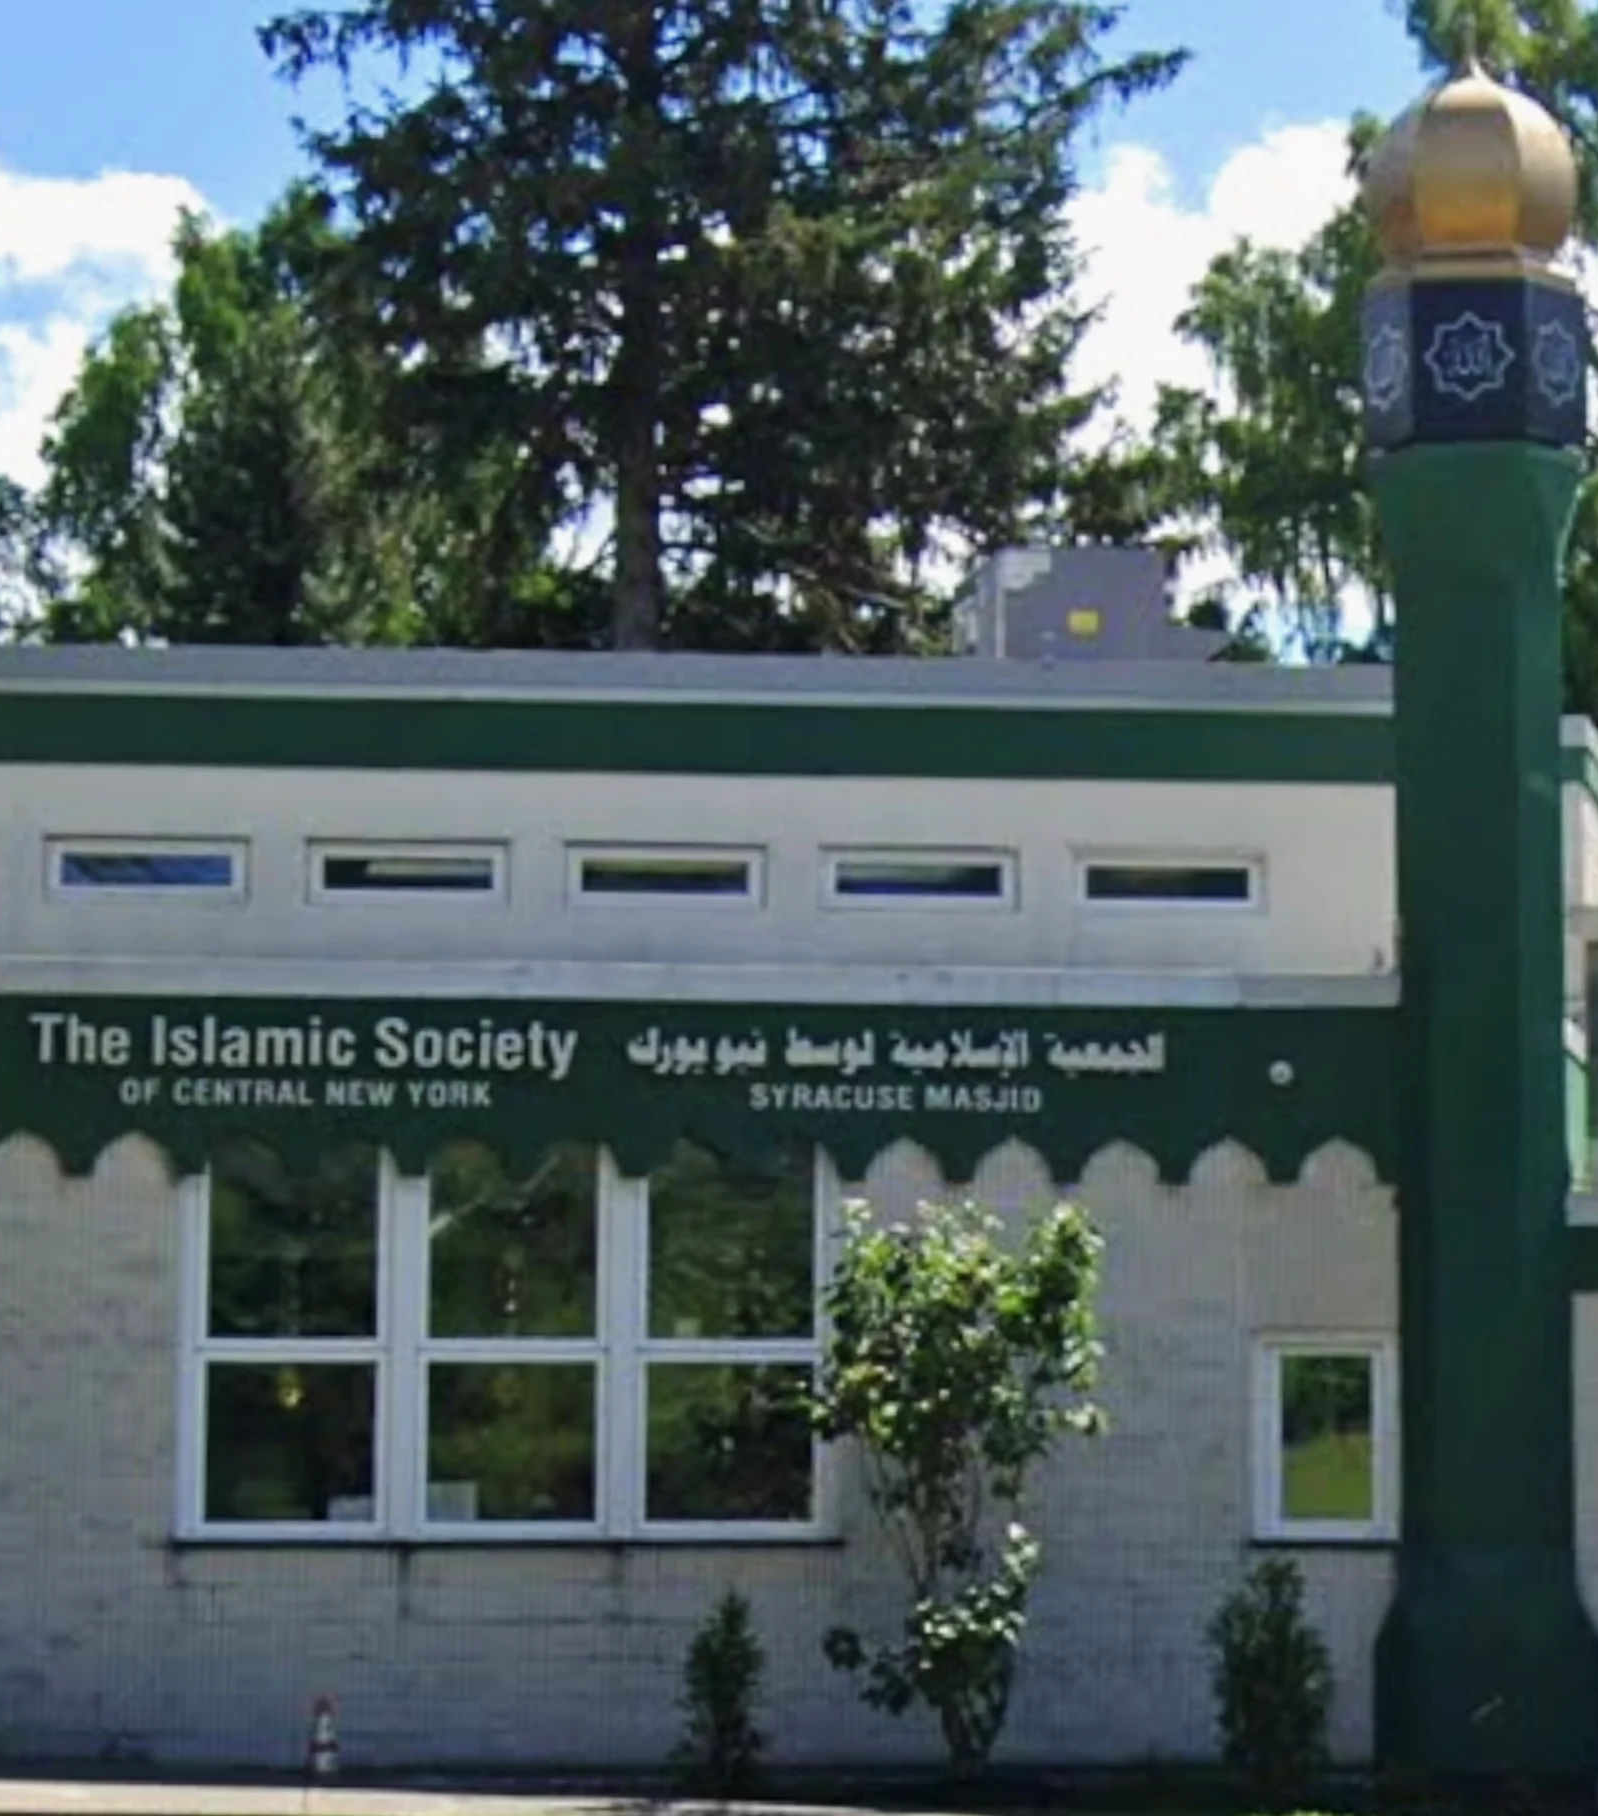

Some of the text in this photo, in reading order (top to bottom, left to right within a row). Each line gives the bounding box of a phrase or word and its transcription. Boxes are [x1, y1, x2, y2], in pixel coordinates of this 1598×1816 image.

[29, 1012, 578, 1080] The Islamic Society
[784, 1026, 875, 1076] لوسط
[119, 1077, 492, 1108] OF CENTRAL NEW YORK
[749, 1082, 1042, 1113] SYRACUSE MASJID
